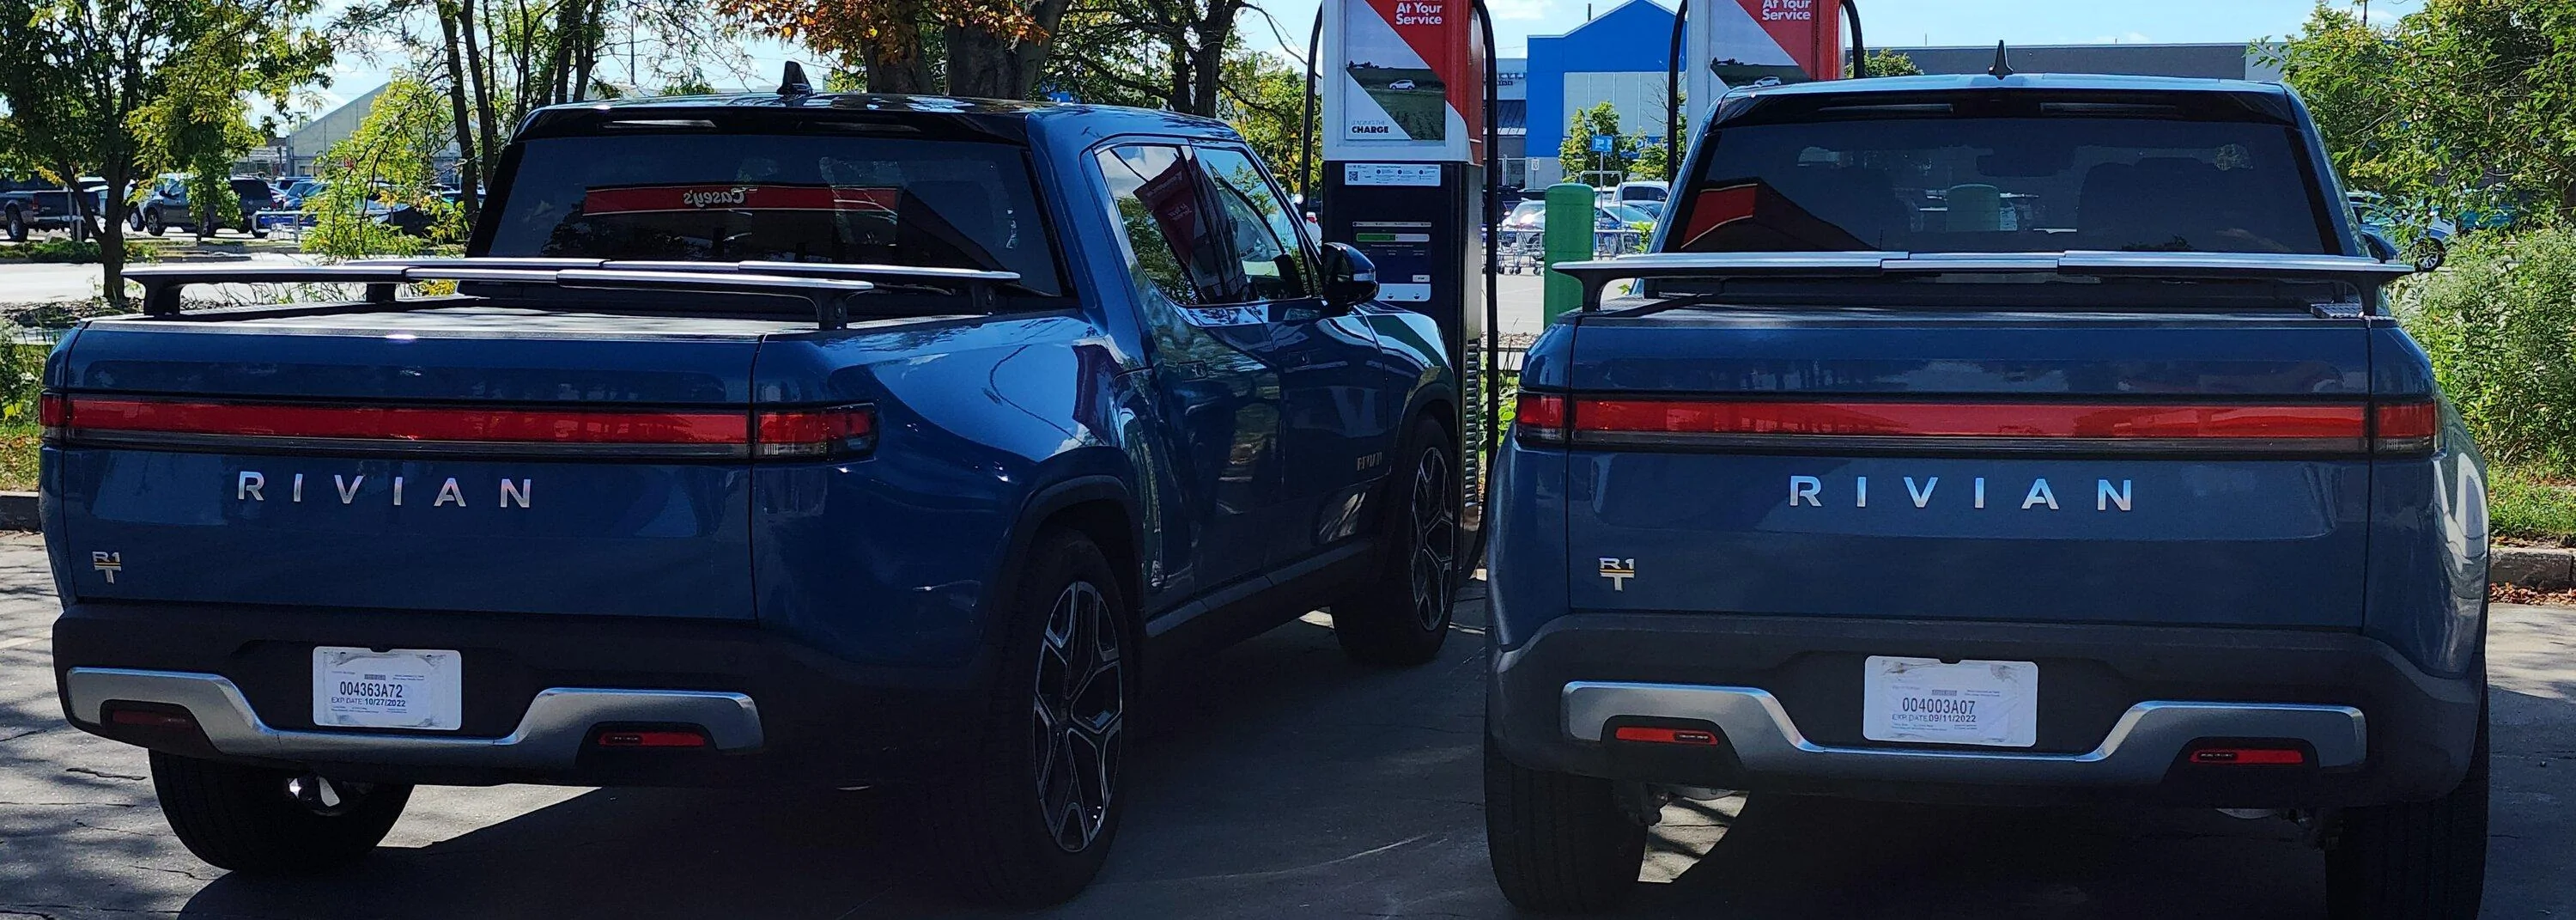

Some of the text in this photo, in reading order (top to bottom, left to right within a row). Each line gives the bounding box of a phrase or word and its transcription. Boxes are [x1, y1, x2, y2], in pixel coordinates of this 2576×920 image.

[1396, 2, 1443, 13] At Your
[1763, 0, 1811, 9] At Your
[1395, 13, 1443, 25] Service
[1762, 8, 1811, 21] Service
[1352, 125, 1389, 134] CHARGE
[238, 471, 532, 508] RIVIAN
[1789, 475, 2131, 511] RIVIAN
[339, 681, 403, 698] 004363A72
[365, 698, 406, 707] 10/27/2022
[1902, 697, 1976, 715] 004003A07
[1929, 714, 1977, 723] 09/11/2022
